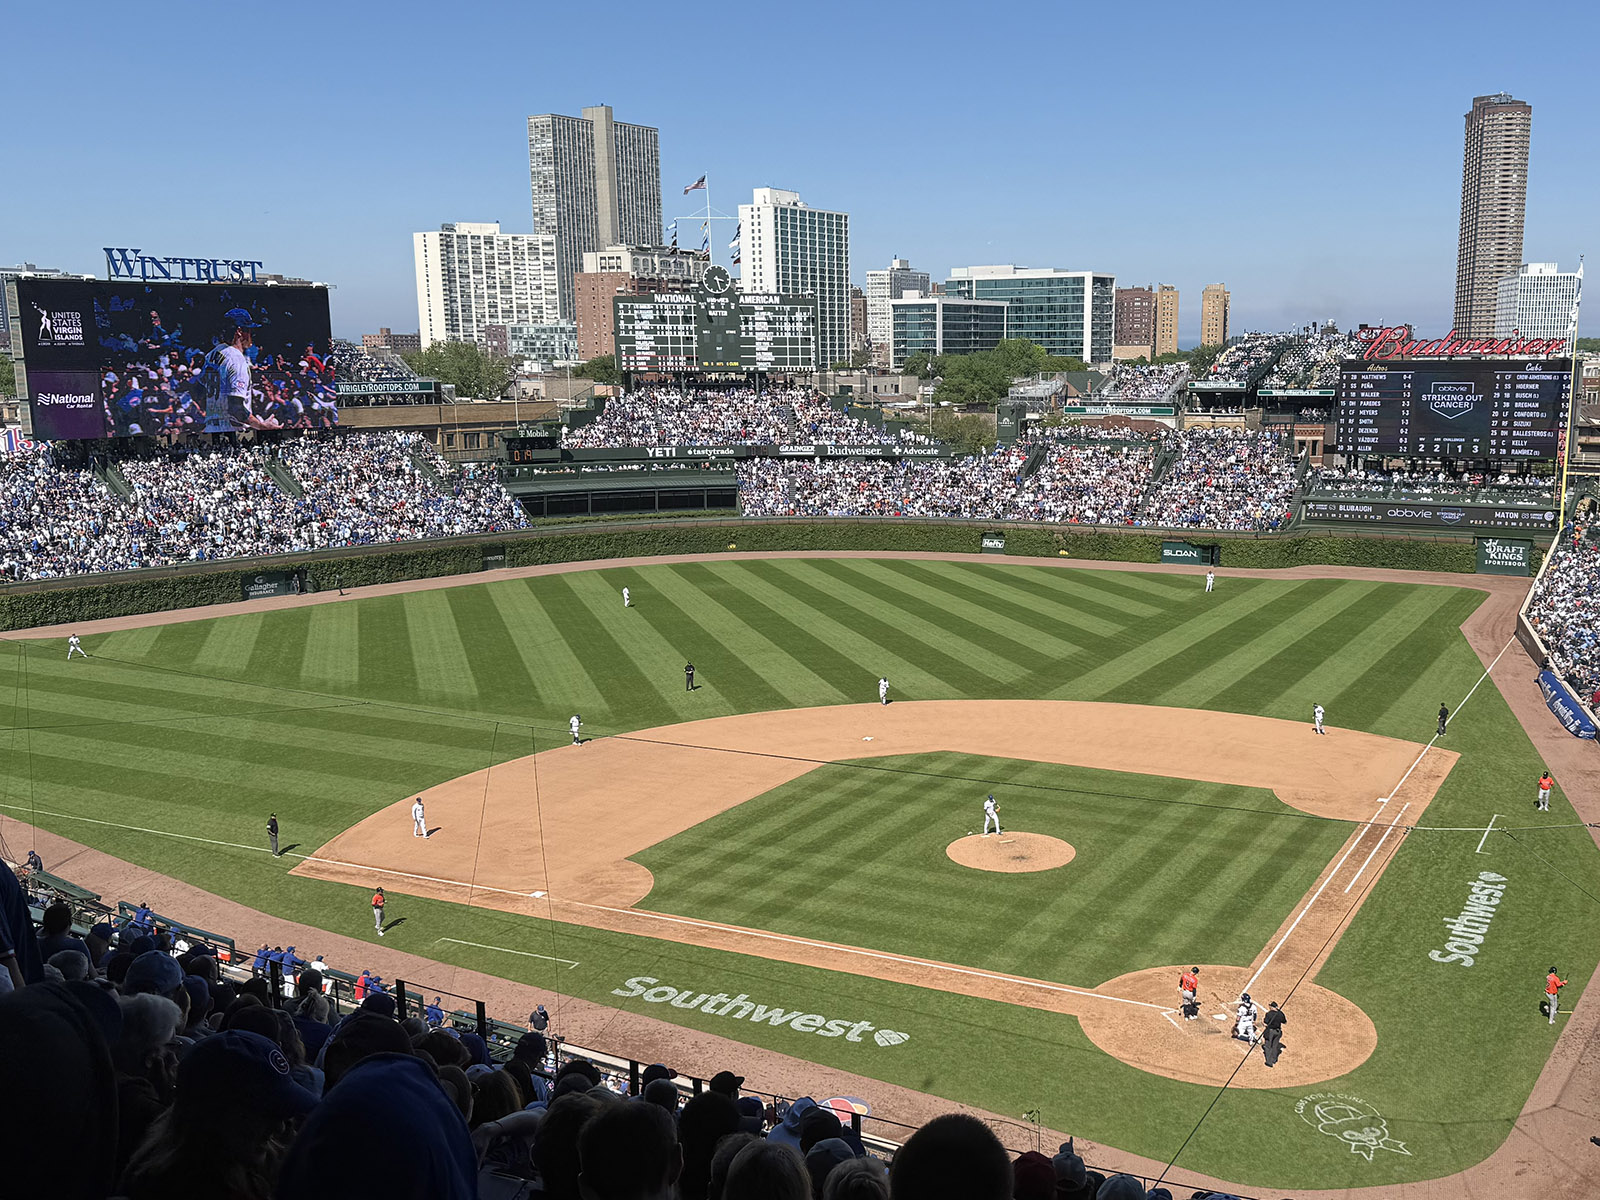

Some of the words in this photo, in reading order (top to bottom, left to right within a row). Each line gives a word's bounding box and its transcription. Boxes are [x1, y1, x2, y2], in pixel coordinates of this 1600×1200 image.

[103, 247, 263, 283] WINTRUST
[654, 294, 696, 303] NATIONAL
[739, 295, 780, 304] AMERICAN
[1356, 326, 1567, 360] Budweiser
[1526, 363, 1542, 371] Cubs
[339, 383, 419, 392] WRIGLEYROOFTOPS.COM
[51, 393, 94, 404] National
[646, 448, 676, 457] YETI
[693, 448, 734, 457] tastytrade
[1387, 508, 1432, 519] abbvie
[1485, 544, 1525, 554] DRAFT
[1490, 552, 1523, 560] KINGS
[245, 582, 278, 591] Gallagher
[1428, 880, 1506, 967] Southwest
[611, 977, 875, 1042] Southwest
[1306, 1092, 1325, 1102] FOR
